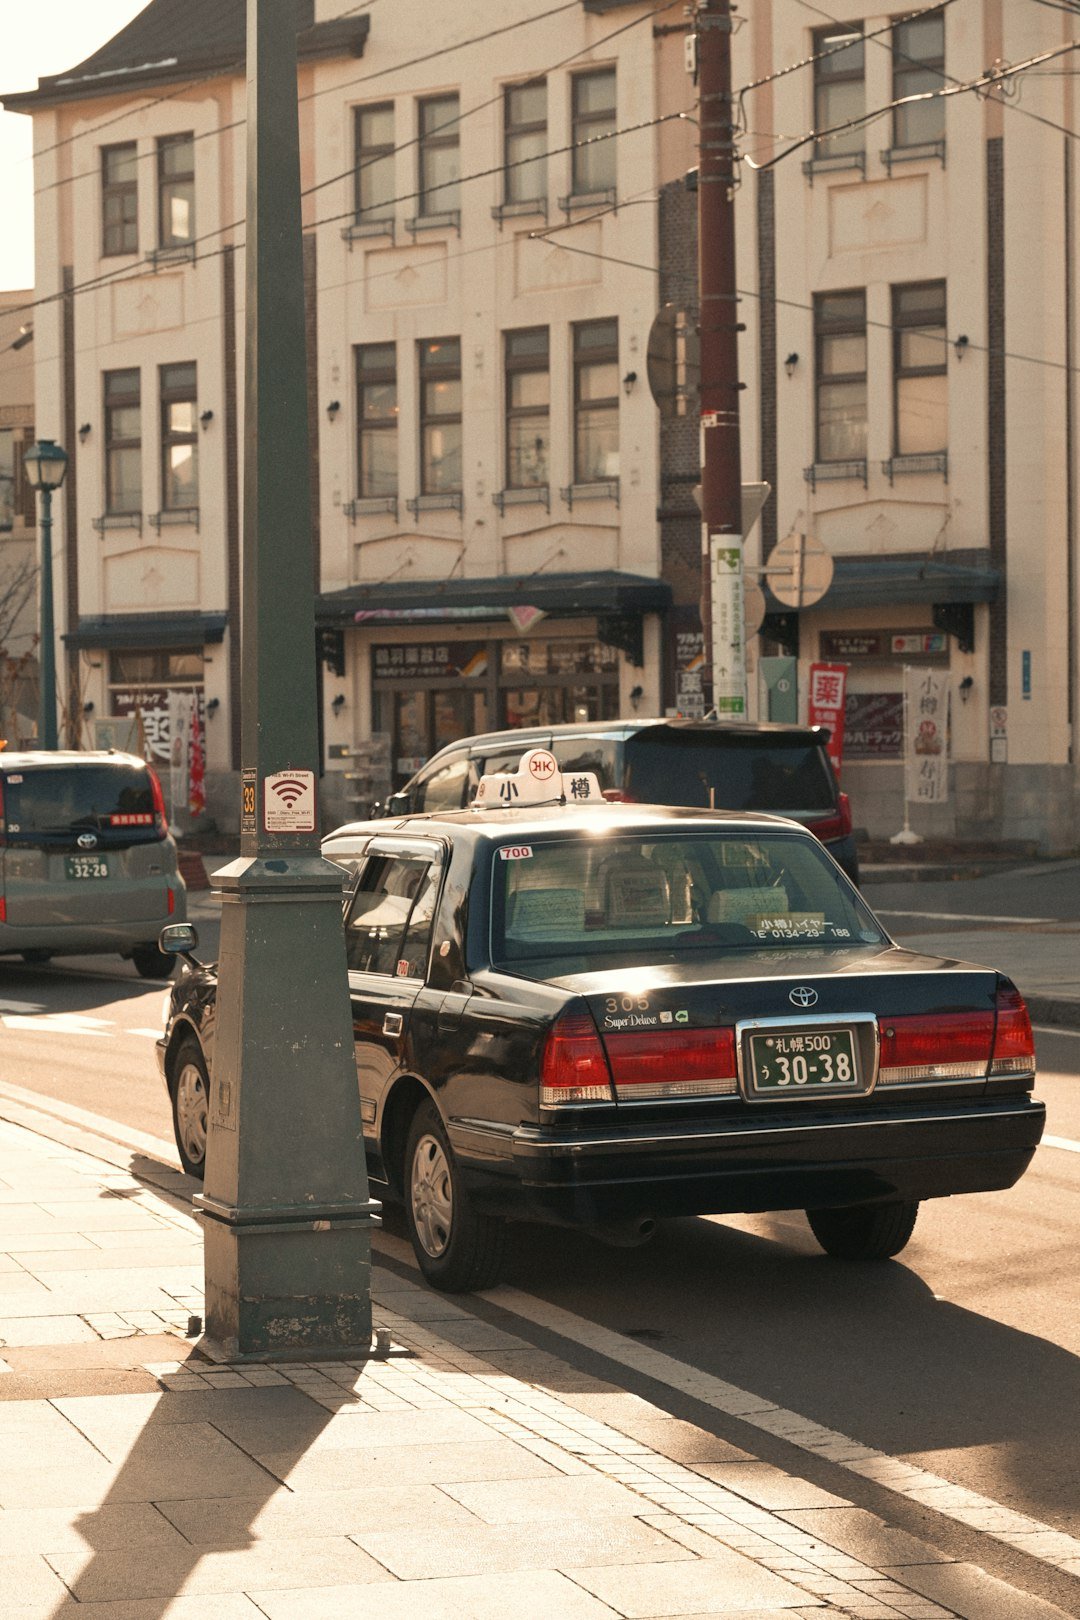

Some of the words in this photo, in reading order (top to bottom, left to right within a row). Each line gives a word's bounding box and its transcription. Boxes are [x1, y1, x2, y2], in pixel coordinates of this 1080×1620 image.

[816, 676, 841, 704] 薬
[244, 787, 255, 813] 33
[502, 847, 530, 859] 700
[75, 864, 108, 878] 32-28
[605, 995, 650, 1013] 305
[604, 1014, 628, 1030] Super
[628, 1013, 657, 1026] Deluxe
[776, 1035, 831, 1053] 札幌500
[775, 1053, 851, 1086] 30-38
